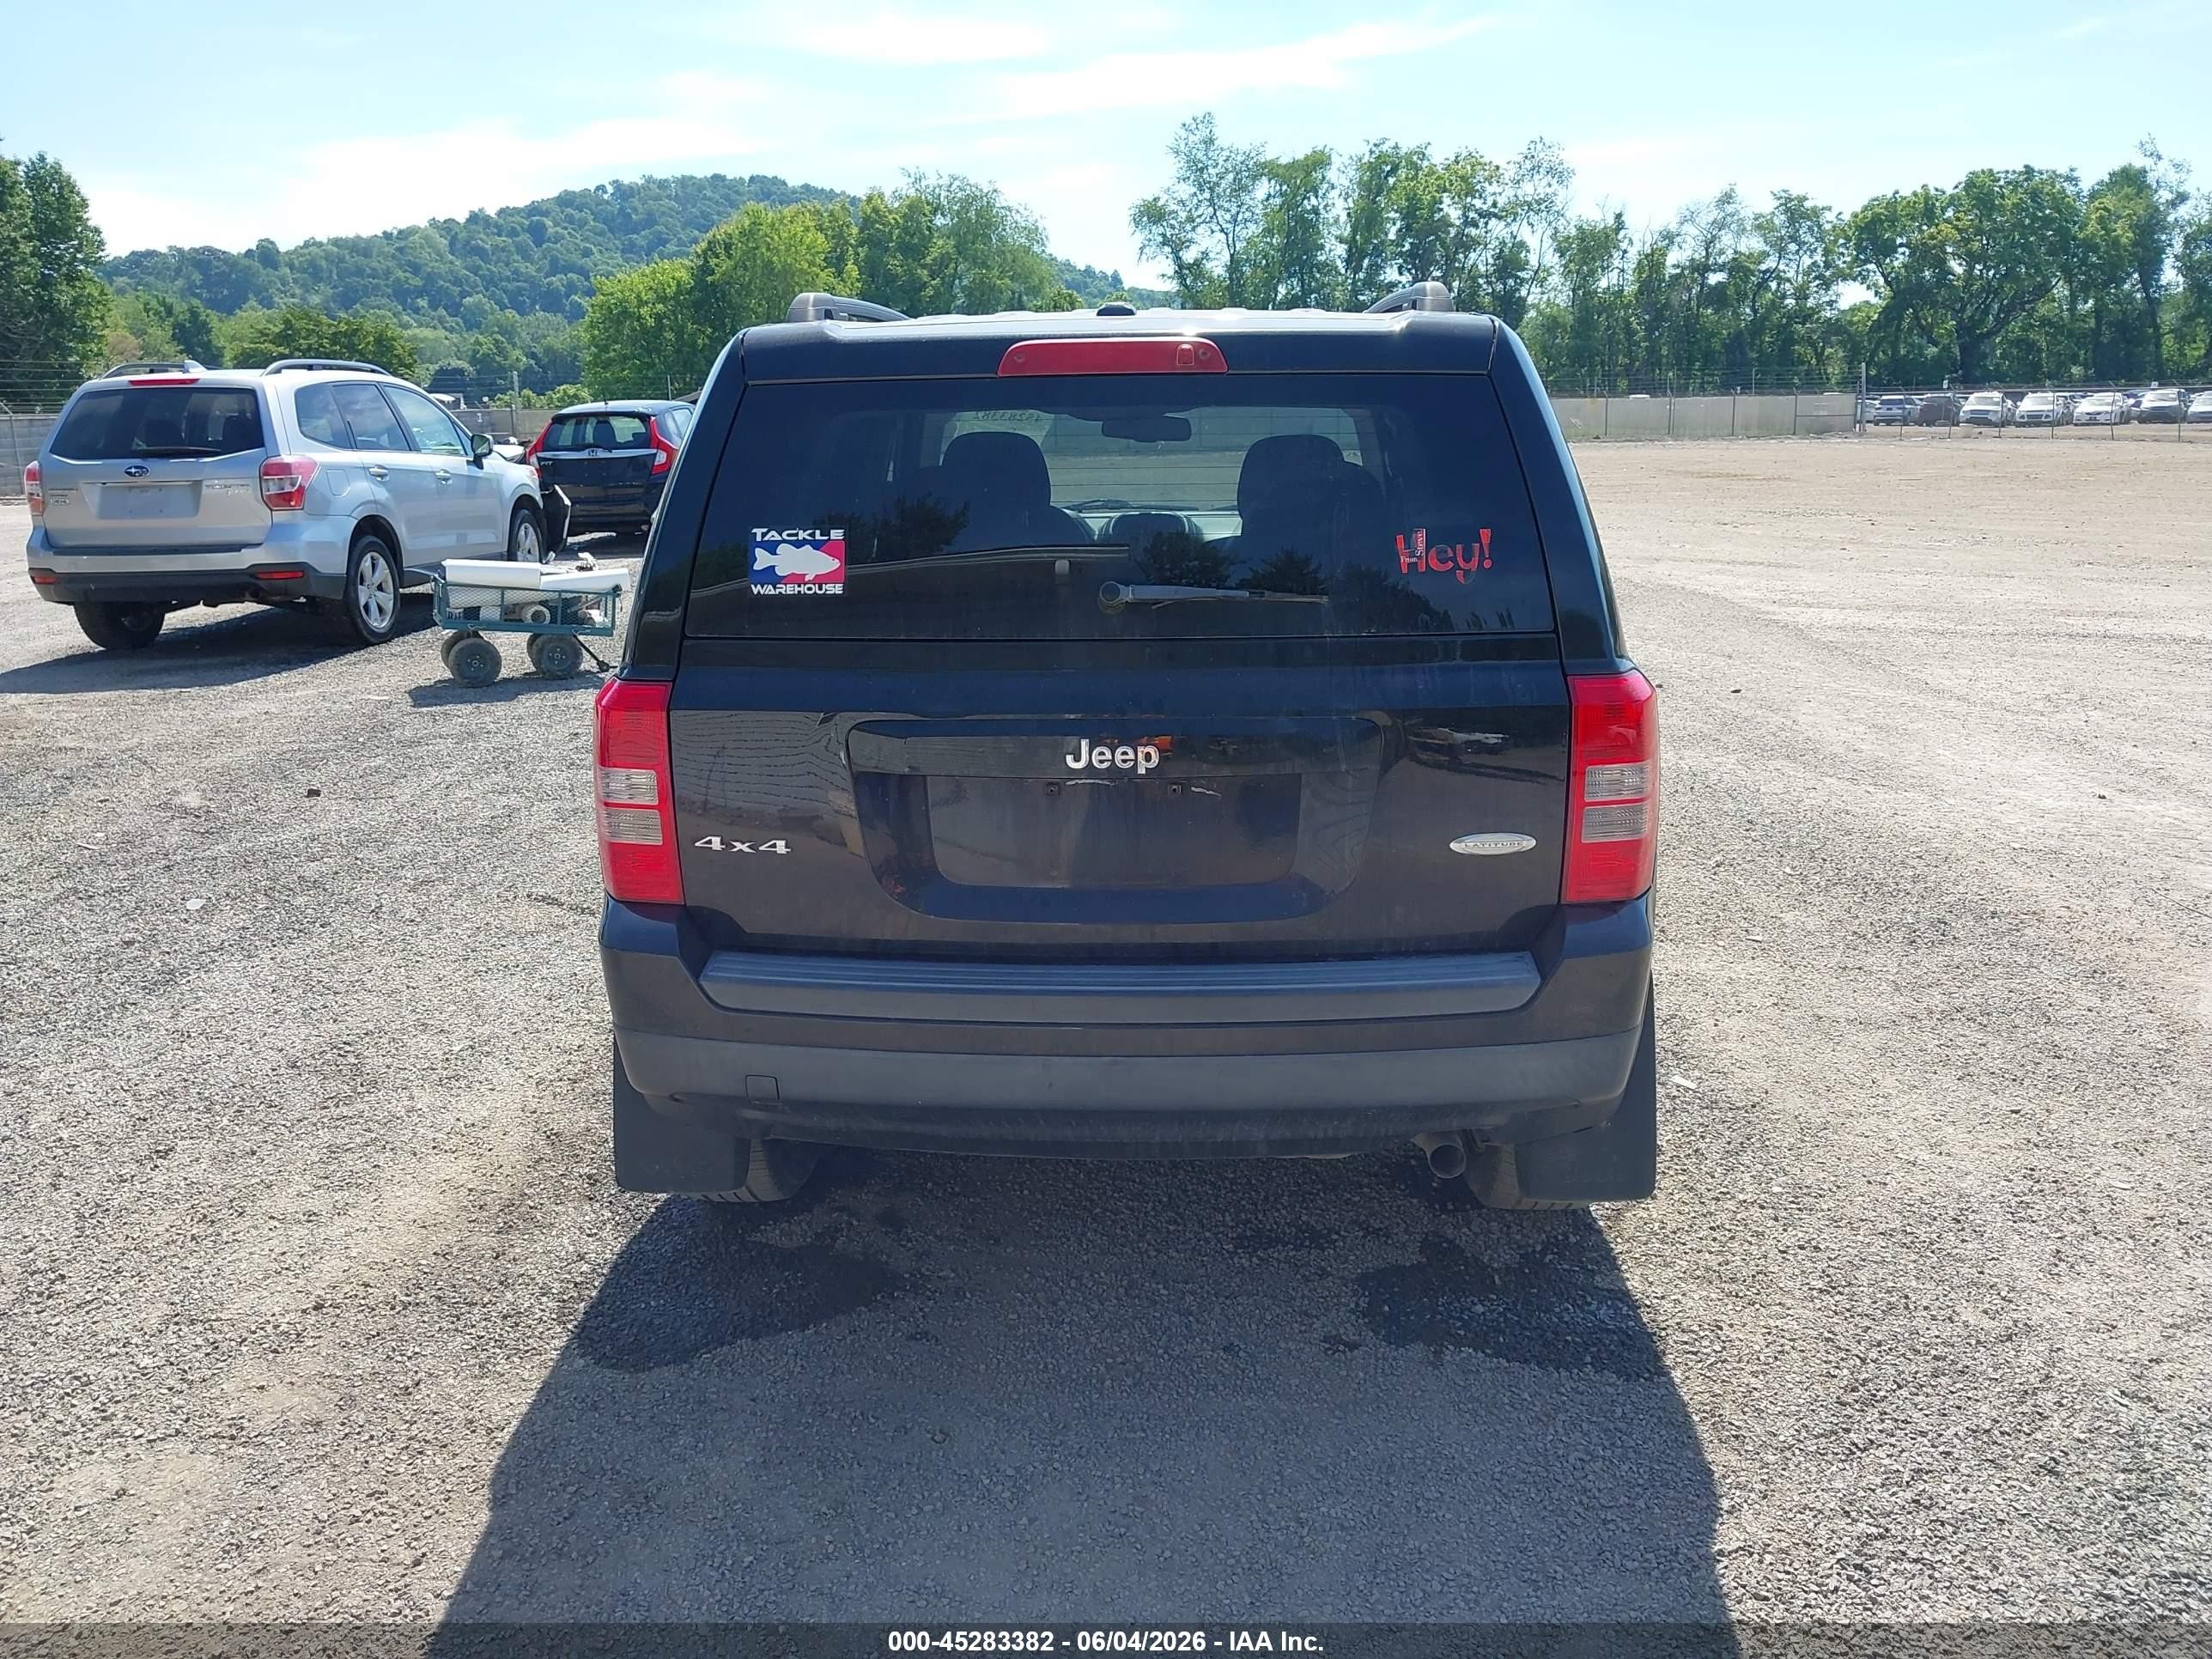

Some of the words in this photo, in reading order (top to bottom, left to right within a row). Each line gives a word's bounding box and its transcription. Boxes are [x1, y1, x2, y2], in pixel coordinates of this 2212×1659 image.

[750, 527, 846, 542] TACKLE
[1395, 528, 1492, 585] Hey!
[750, 584, 844, 595] WAREHOUSE
[1066, 738, 1160, 775] Jeep
[694, 836, 792, 854] 4x4
